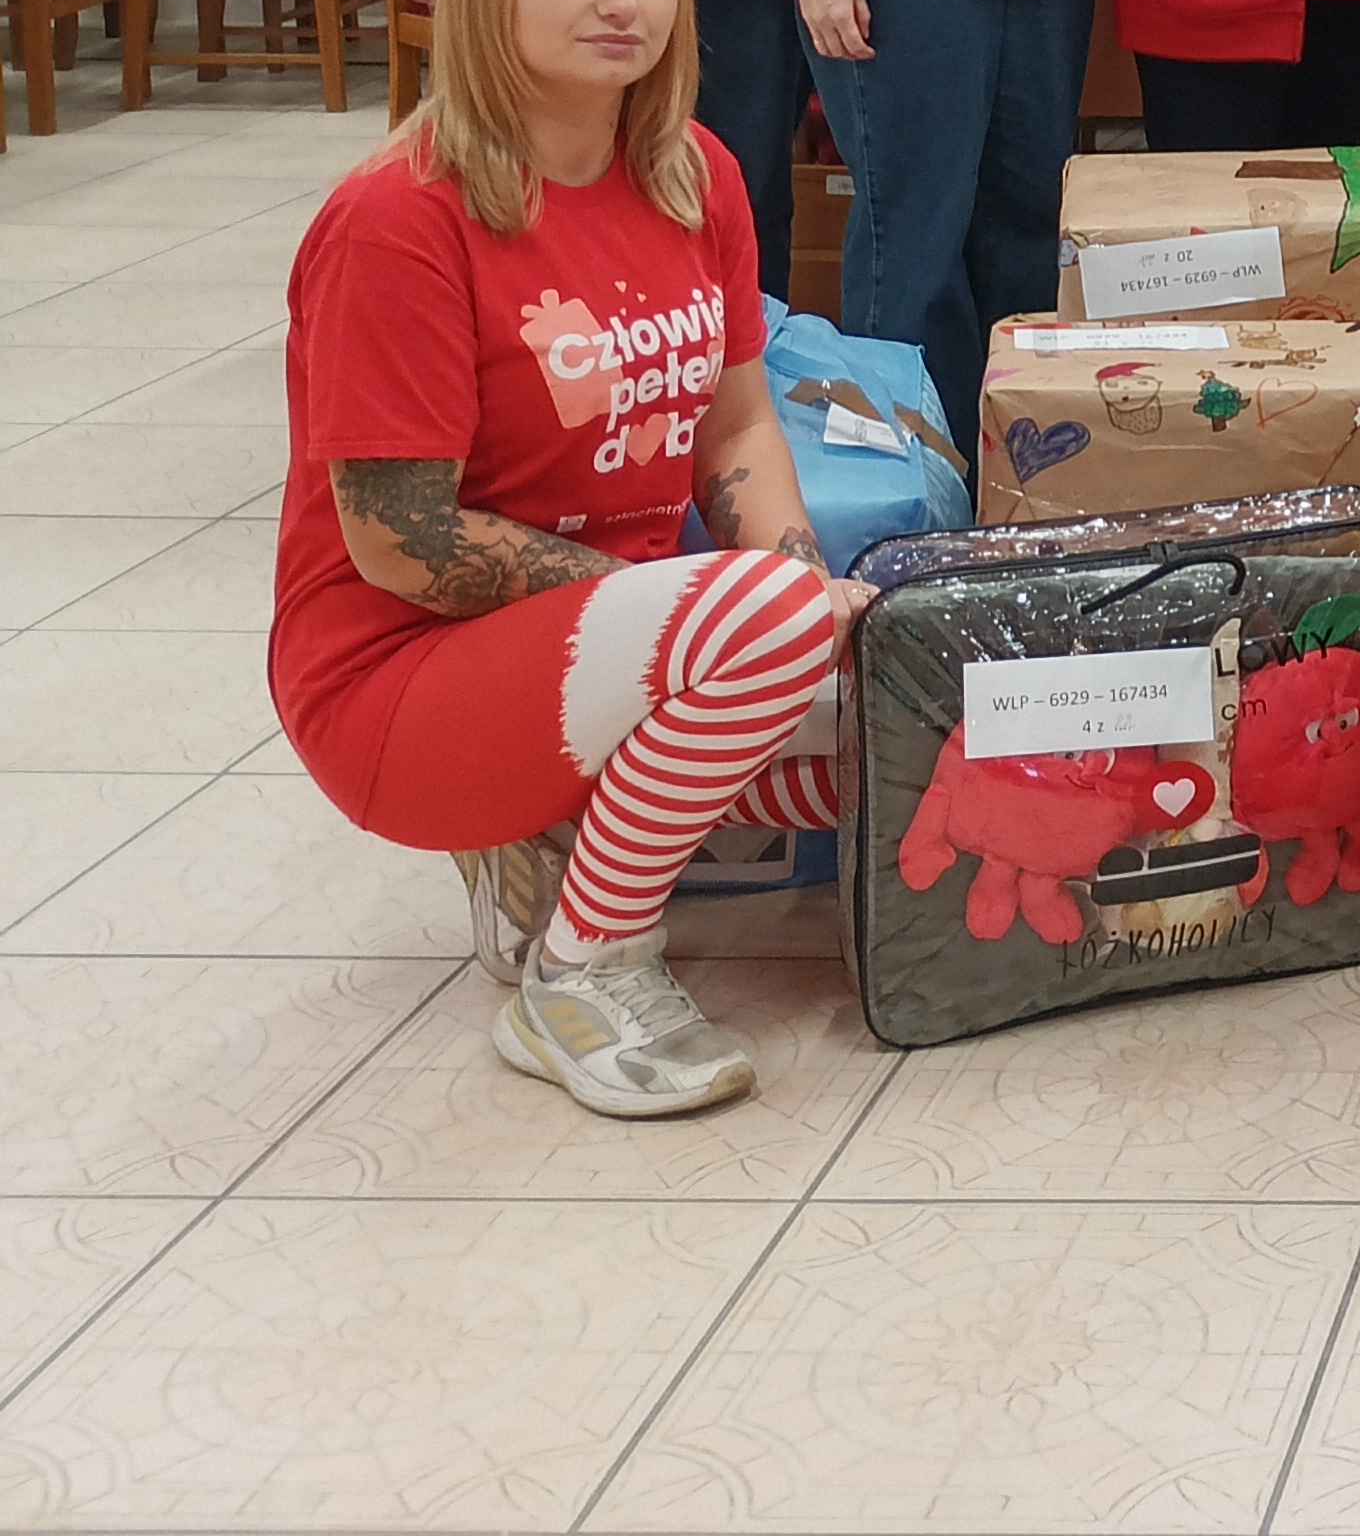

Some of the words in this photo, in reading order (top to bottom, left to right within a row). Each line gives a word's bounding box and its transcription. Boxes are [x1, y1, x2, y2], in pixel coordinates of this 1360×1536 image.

[1176, 249, 1194, 262] 20
[1184, 269, 1217, 284] 6929
[1232, 264, 1261, 279] WLP
[1120, 275, 1168, 293] 167434
[992, 695, 1030, 712] WLP
[1049, 690, 1090, 708] 6929
[1109, 684, 1168, 703] 167434
[1221, 699, 1267, 721] cm
[1082, 720, 1092, 734] 4
[1097, 721, 1105, 733] z
[1055, 905, 1277, 978] ŁÓŻKOHOLICY
